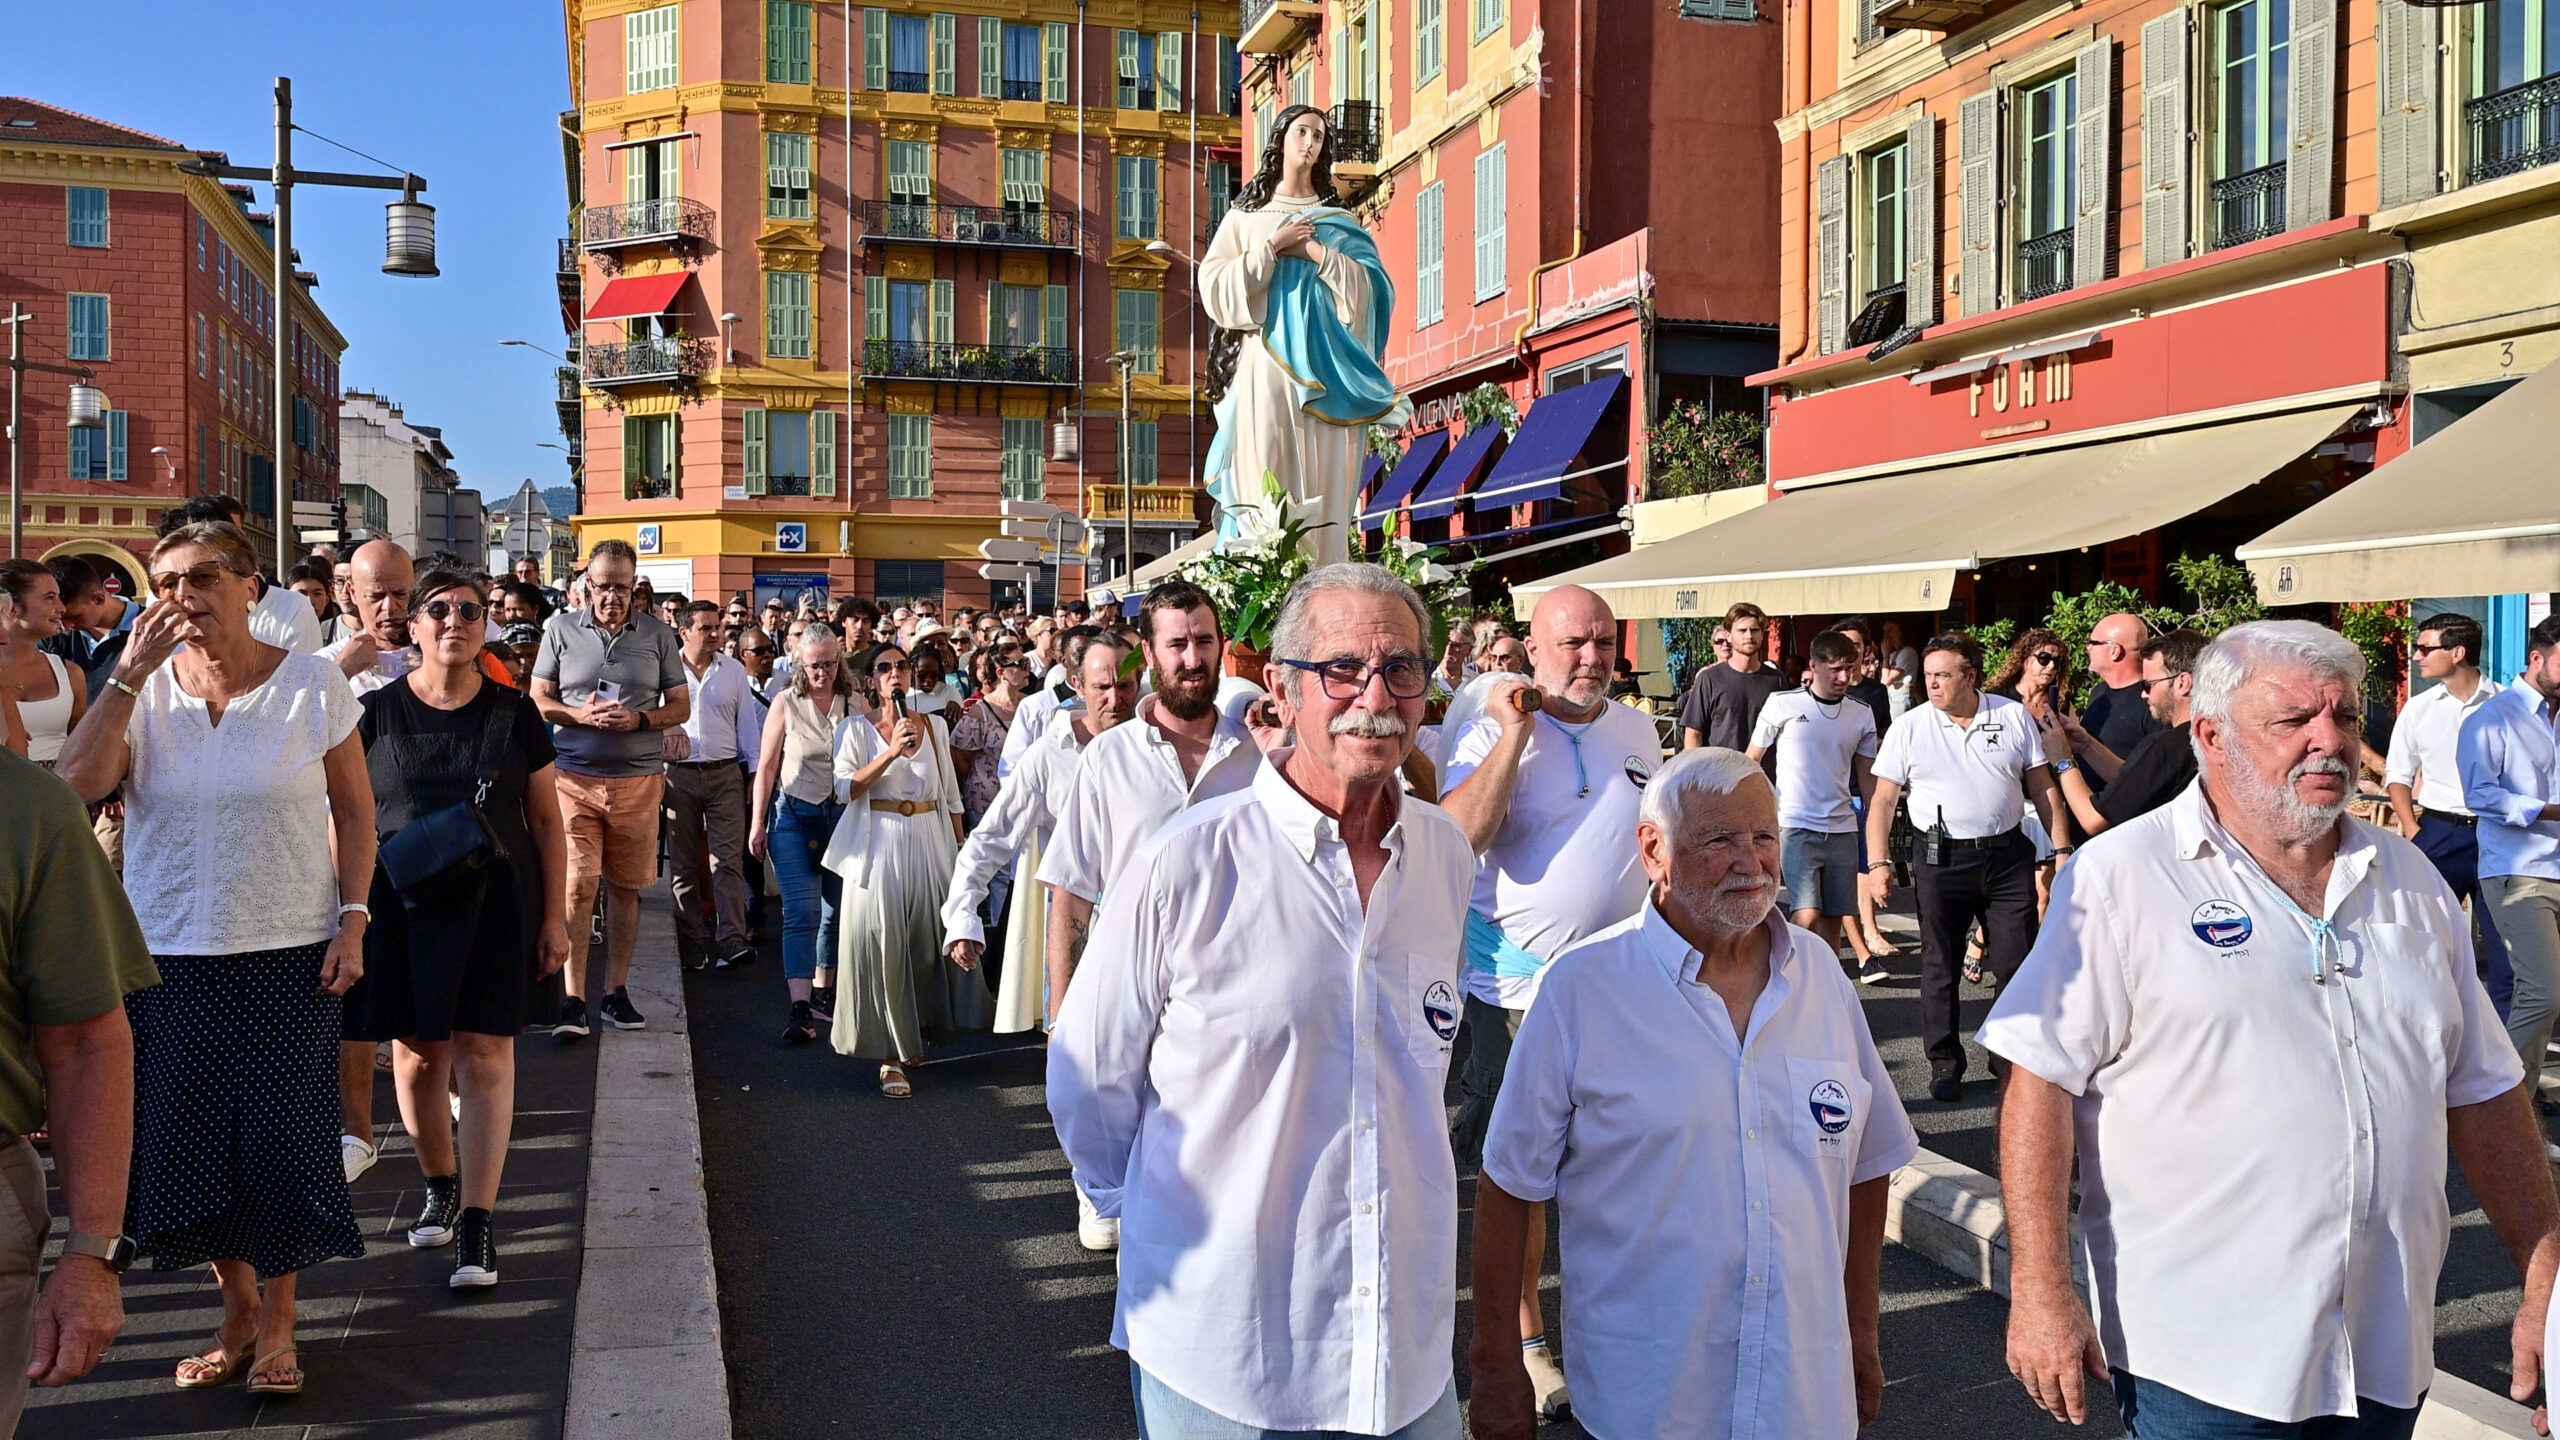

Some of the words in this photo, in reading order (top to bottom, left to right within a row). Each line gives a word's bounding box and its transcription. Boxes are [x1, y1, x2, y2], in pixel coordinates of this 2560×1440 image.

[2500, 341, 2514, 368] 3
[1969, 352, 2072, 418] FOAM
[1412, 391, 1465, 429] VIGNA
[1676, 590, 1698, 611] FOAM
